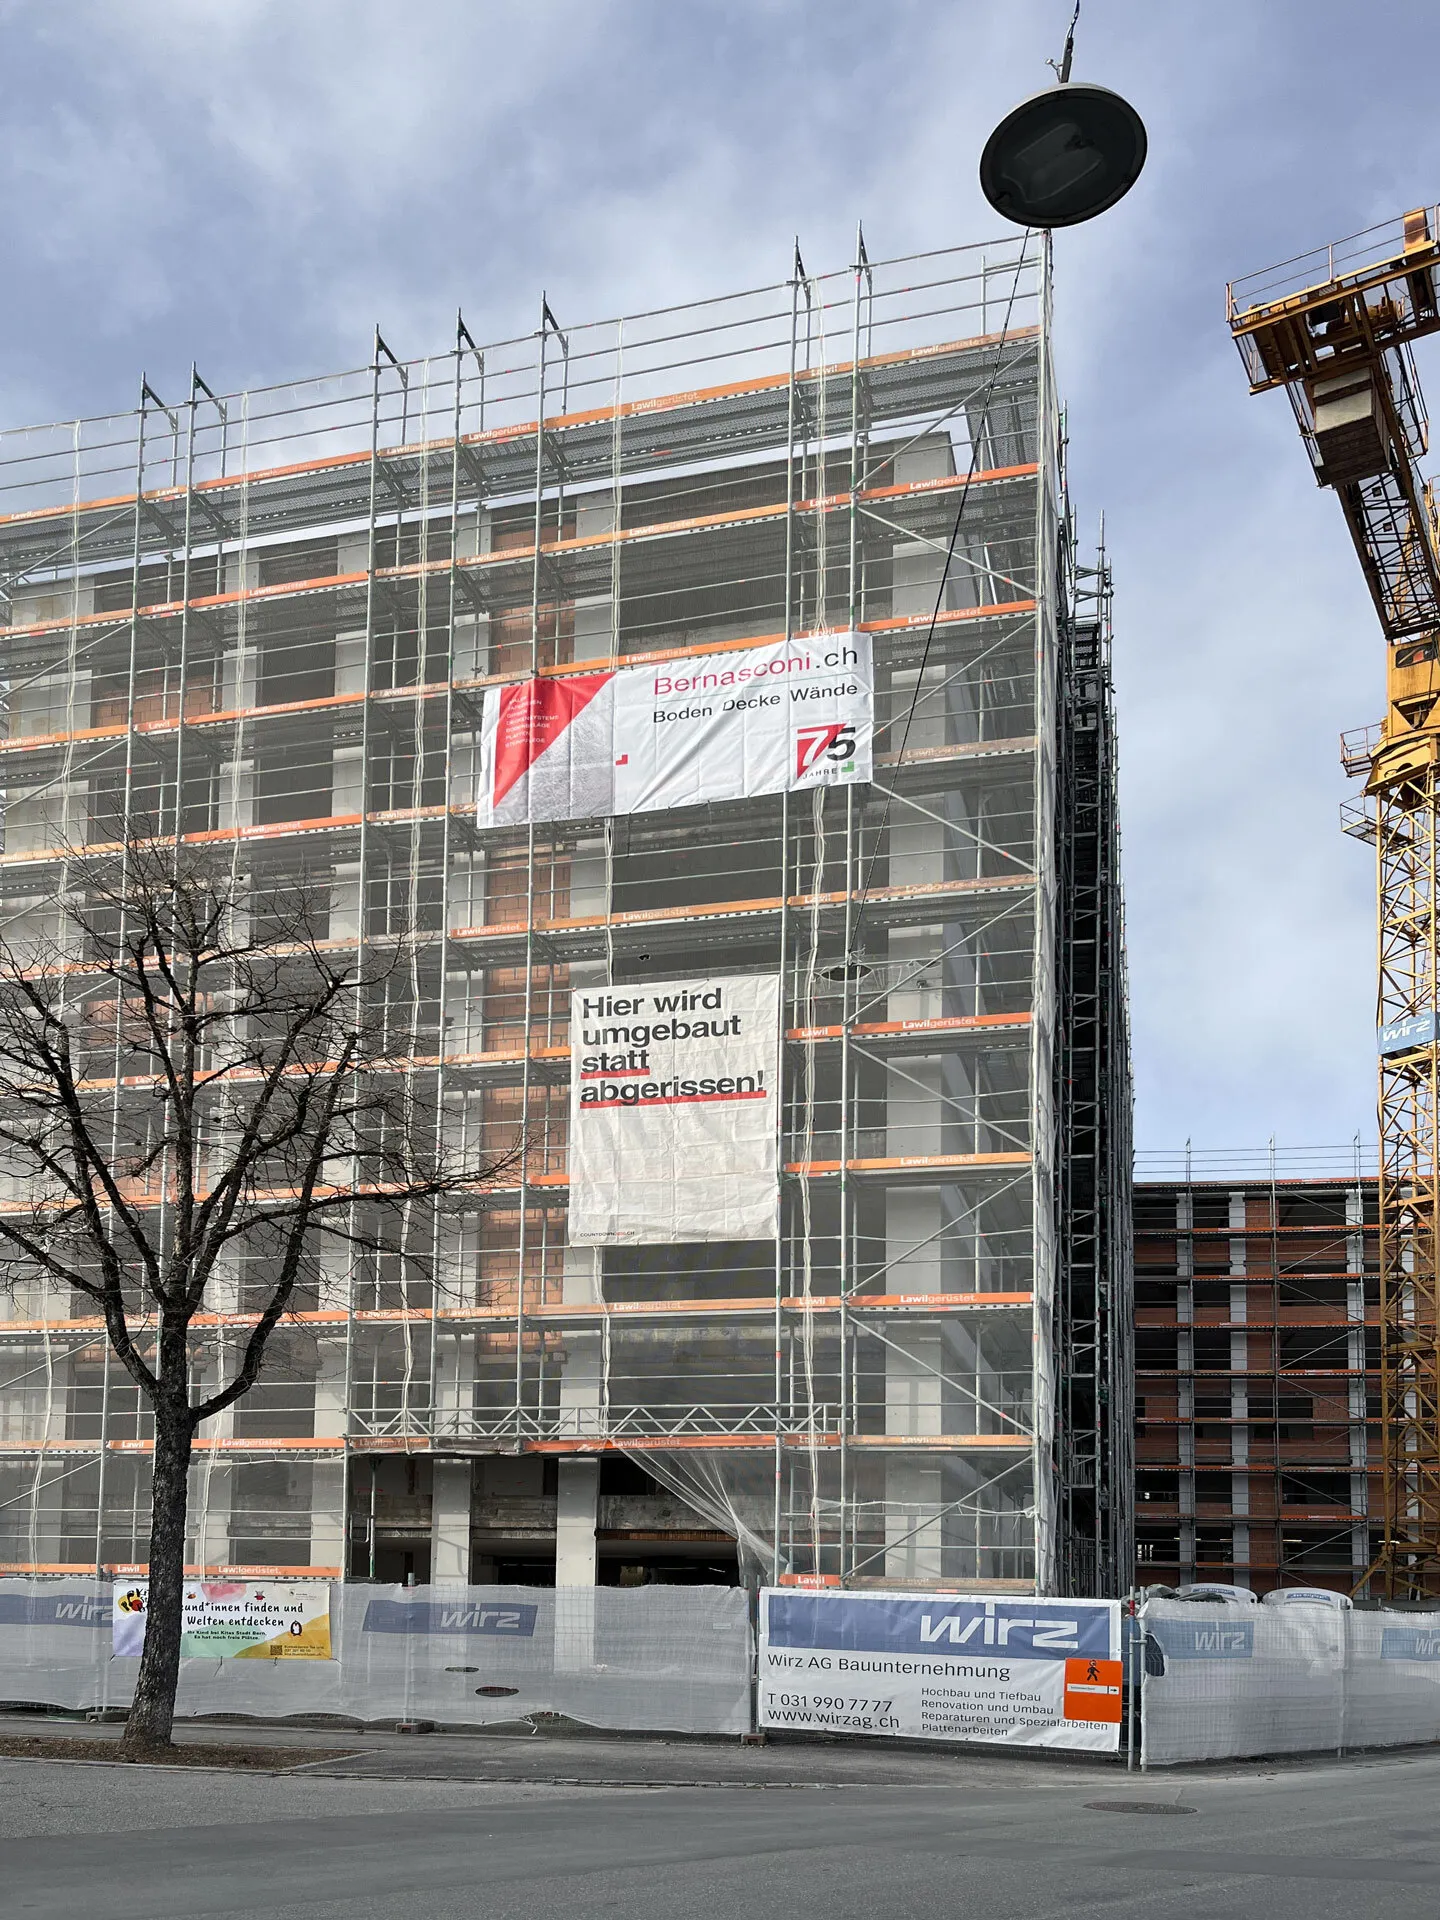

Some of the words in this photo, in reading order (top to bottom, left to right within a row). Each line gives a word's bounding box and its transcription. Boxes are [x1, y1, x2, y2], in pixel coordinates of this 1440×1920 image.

[653, 706, 713, 723] Boden
[723, 694, 781, 712] Decke
[790, 682, 858, 702] Wände
[798, 725, 857, 768] 75
[801, 767, 838, 779] JAHRE
[583, 996, 644, 1018] Hier
[654, 988, 722, 1012] wird
[583, 1015, 741, 1048] umgebaut
[582, 1050, 650, 1072] statt
[580, 1070, 764, 1106] abgerissen!
[900, 1294, 977, 1303] Lawilgerüstet.
[798, 1576, 825, 1584] Lawil
[181, 1602, 240, 1612] undinnen
[244, 1602, 280, 1613] finden
[284, 1602, 303, 1613] und
[440, 1598, 520, 1628] wirz
[187, 1616, 224, 1626] Welten
[229, 1616, 284, 1627] entdecken
[920, 1602, 1079, 1649] wirz
[1195, 1621, 1245, 1650] wirz
[1416, 1630, 1440, 1655] wir
[768, 1654, 803, 1668] Wirz
[808, 1657, 832, 1669] AG
[838, 1658, 1010, 1681] Bauunternehmung
[768, 1693, 776, 1704] T
[781, 1694, 807, 1707] 031
[814, 1696, 844, 1709] 990
[921, 1688, 970, 1698] Hochbau
[974, 1691, 995, 1699] und
[999, 1692, 1041, 1701] Tiefbau
[921, 1700, 983, 1711] Renovation
[988, 1704, 1009, 1712] und
[1013, 1705, 1054, 1714] Umbau
[768, 1710, 899, 1729] www.wirzag.ch
[921, 1712, 990, 1723] Reparaturen
[994, 1716, 1015, 1725] und
[1019, 1718, 1108, 1730] Spezialarbeiten
[922, 1724, 1008, 1736] Plattenarbeiten
